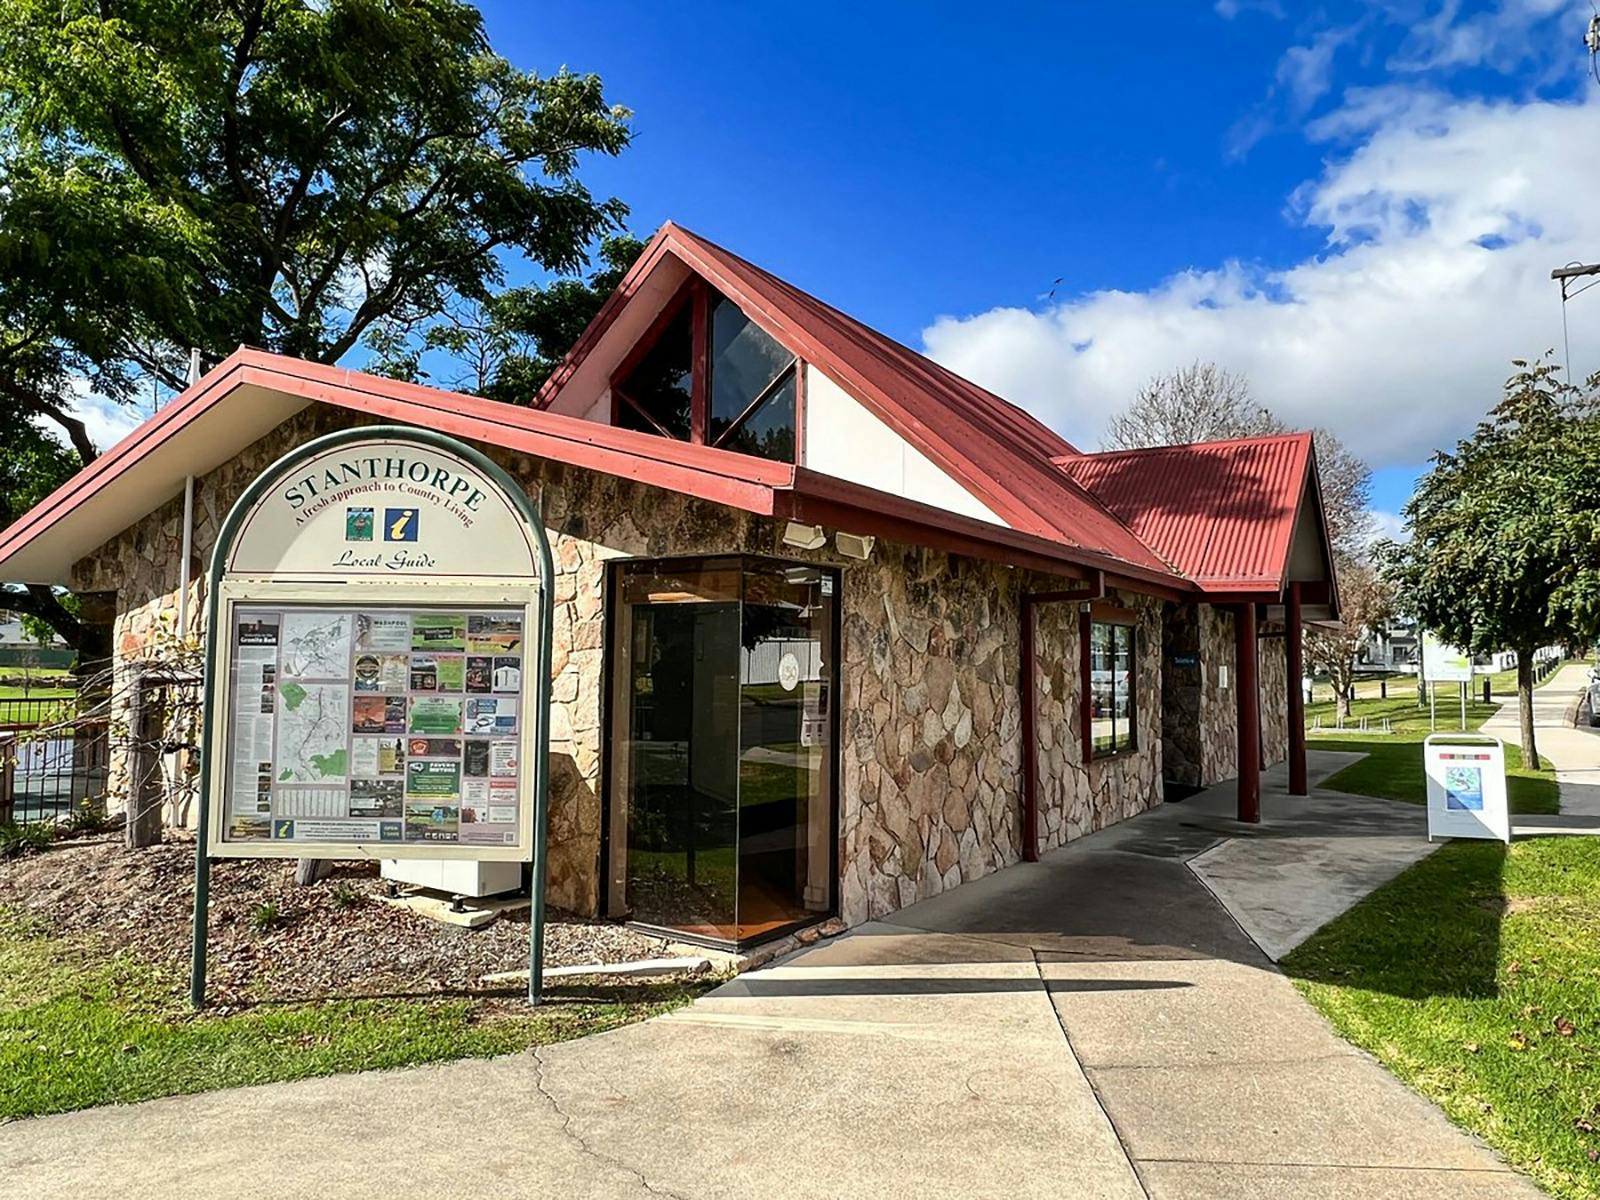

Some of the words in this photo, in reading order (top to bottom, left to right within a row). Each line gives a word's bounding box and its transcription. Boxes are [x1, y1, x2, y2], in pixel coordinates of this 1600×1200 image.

[284, 458, 487, 512] STANTHORPE
[295, 517, 305, 528] A
[303, 498, 330, 518] fresh
[330, 481, 381, 502] approach
[384, 483, 396, 491] to
[398, 482, 440, 505] Country
[444, 499, 474, 528] Living
[332, 550, 382, 567] Local
[385, 550, 435, 570] Guide
